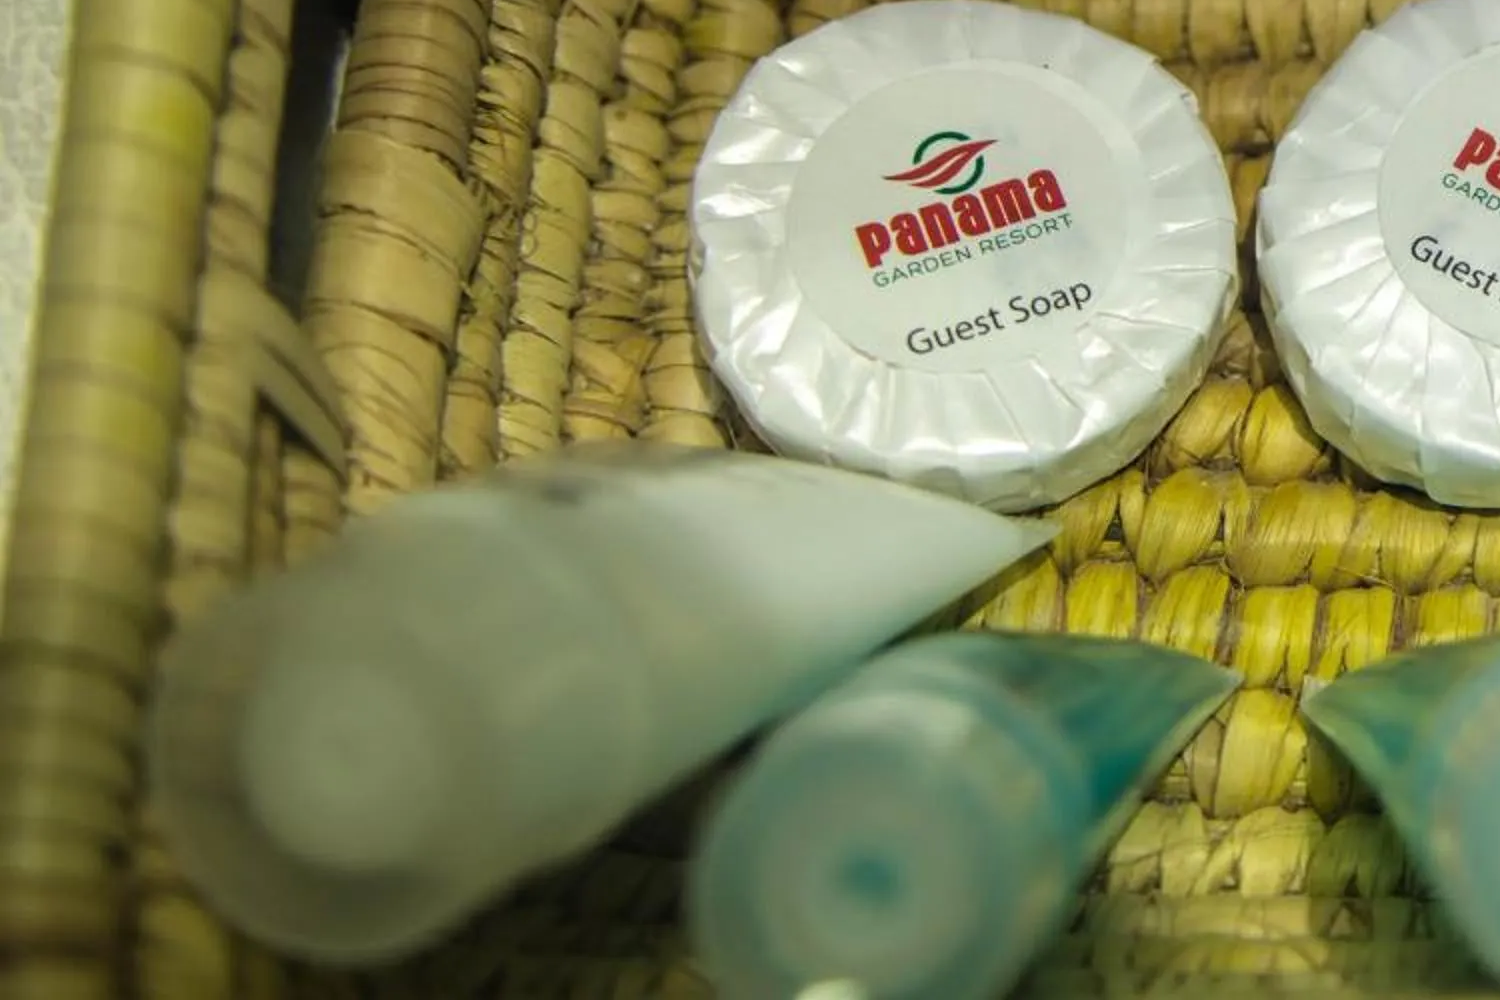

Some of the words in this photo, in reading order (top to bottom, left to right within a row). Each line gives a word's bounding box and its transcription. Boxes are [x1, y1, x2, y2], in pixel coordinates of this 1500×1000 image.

[872, 246, 972, 288] GARDEN
[979, 213, 1073, 256] RESORT
[1410, 234, 1498, 296] Guest
[906, 307, 1005, 355] Guest
[1008, 282, 1092, 324] Soap
